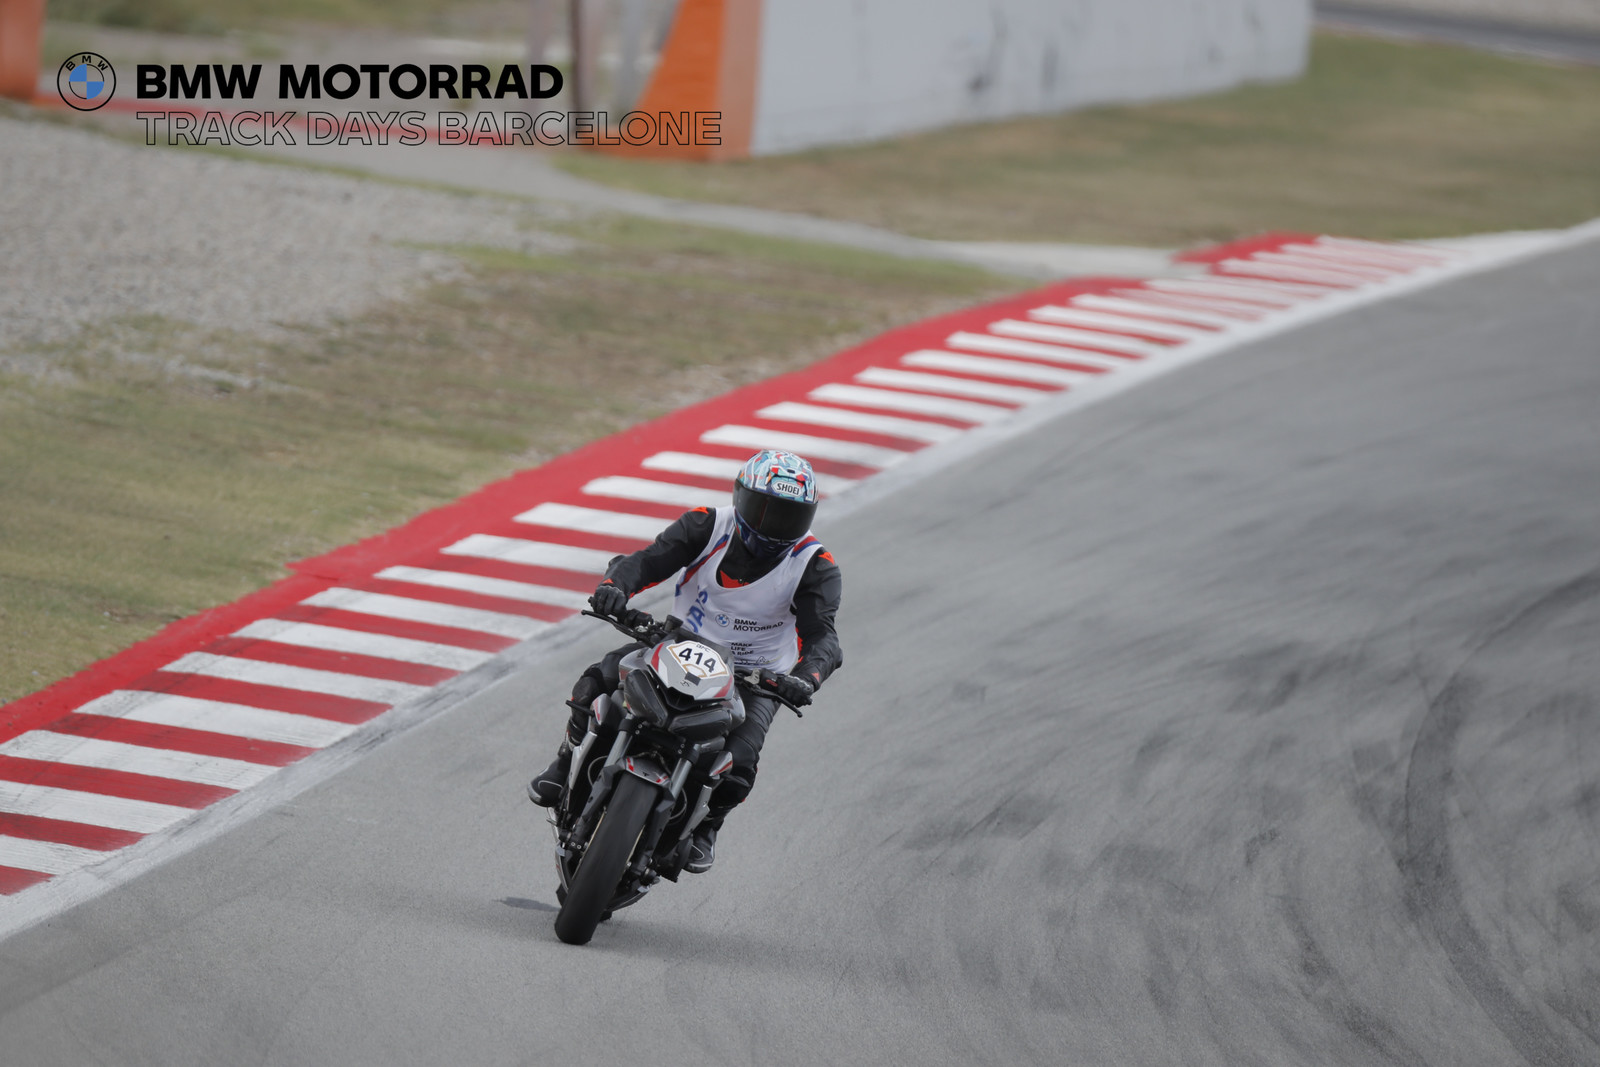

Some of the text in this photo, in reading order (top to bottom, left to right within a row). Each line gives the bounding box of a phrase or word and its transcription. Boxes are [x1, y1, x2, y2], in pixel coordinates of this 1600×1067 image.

[776, 482, 800, 496] SHOEI
[733, 621, 784, 632] MOTORRAD
[734, 618, 758, 626] BMW
[678, 647, 717, 674] 414
